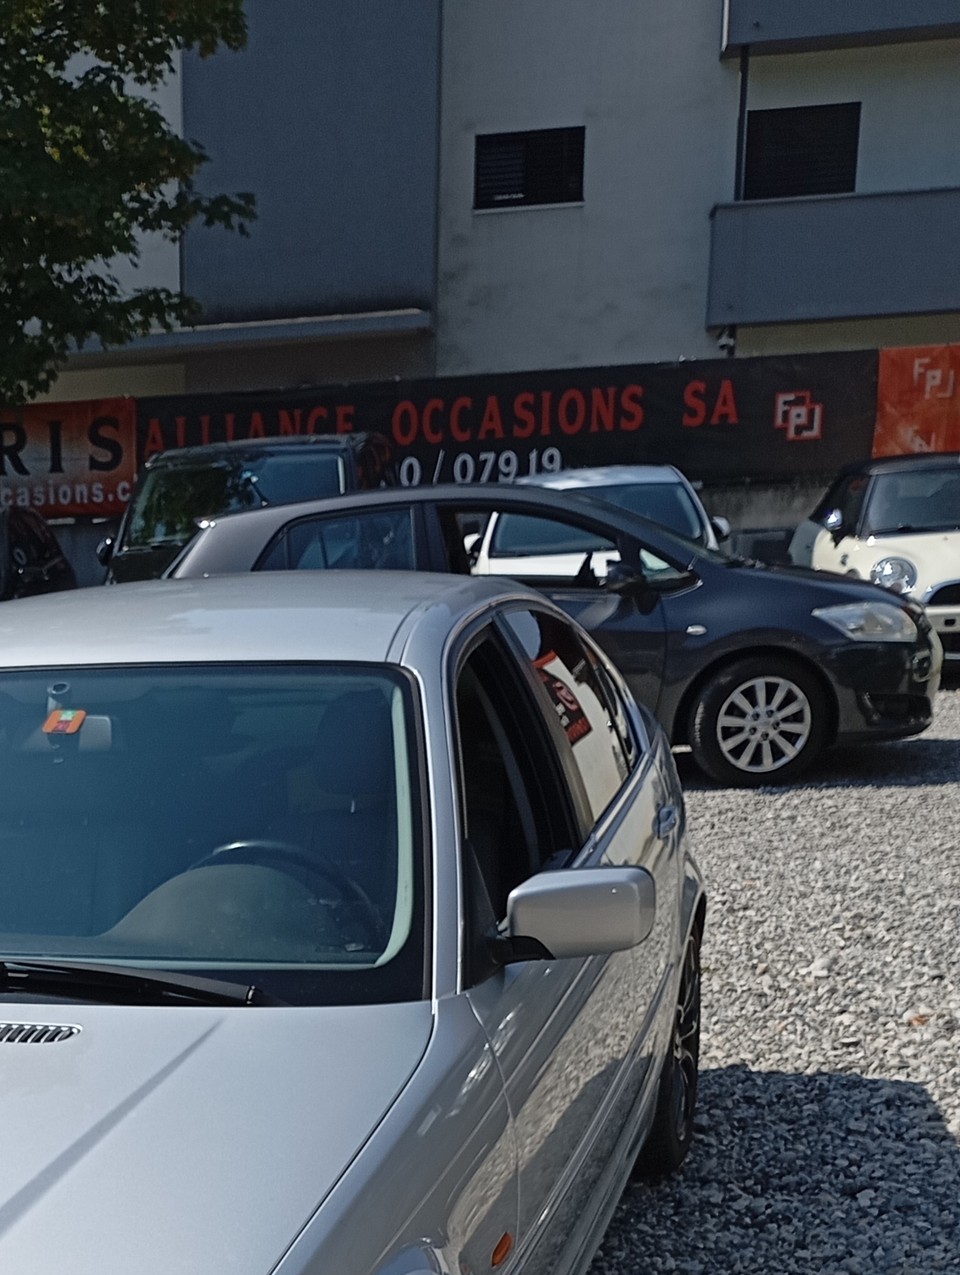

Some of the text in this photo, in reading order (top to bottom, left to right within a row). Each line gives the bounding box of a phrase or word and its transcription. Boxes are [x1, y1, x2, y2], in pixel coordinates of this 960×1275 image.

[143, 379, 738, 458] ALLIANCE OCCASIONS SA
[453, 450, 518, 485] 079
